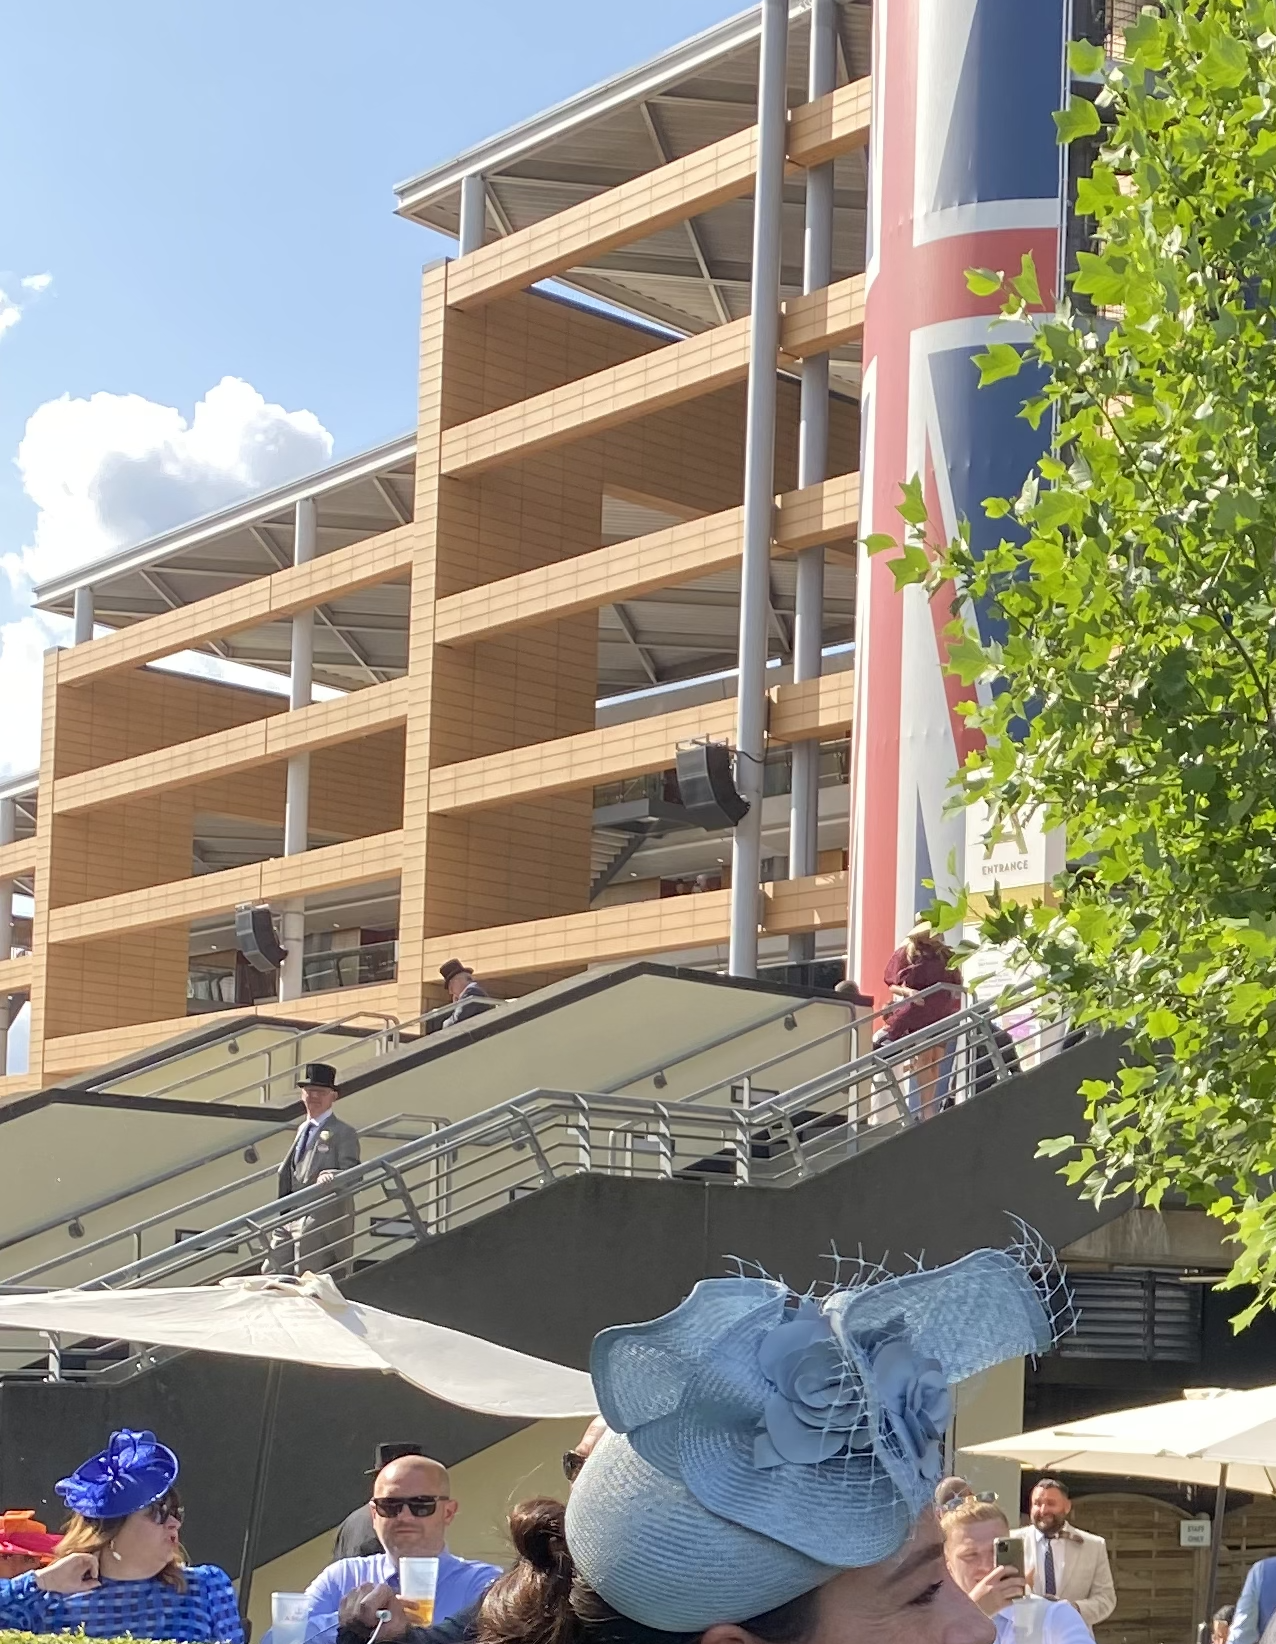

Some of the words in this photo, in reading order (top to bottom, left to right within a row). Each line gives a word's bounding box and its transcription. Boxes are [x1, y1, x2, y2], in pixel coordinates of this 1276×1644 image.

[983, 807, 1028, 860] A
[982, 860, 1029, 876] ENTRANCE
[1187, 1525, 1205, 1533] STAFF
[1187, 1535, 1205, 1543] ONLY
